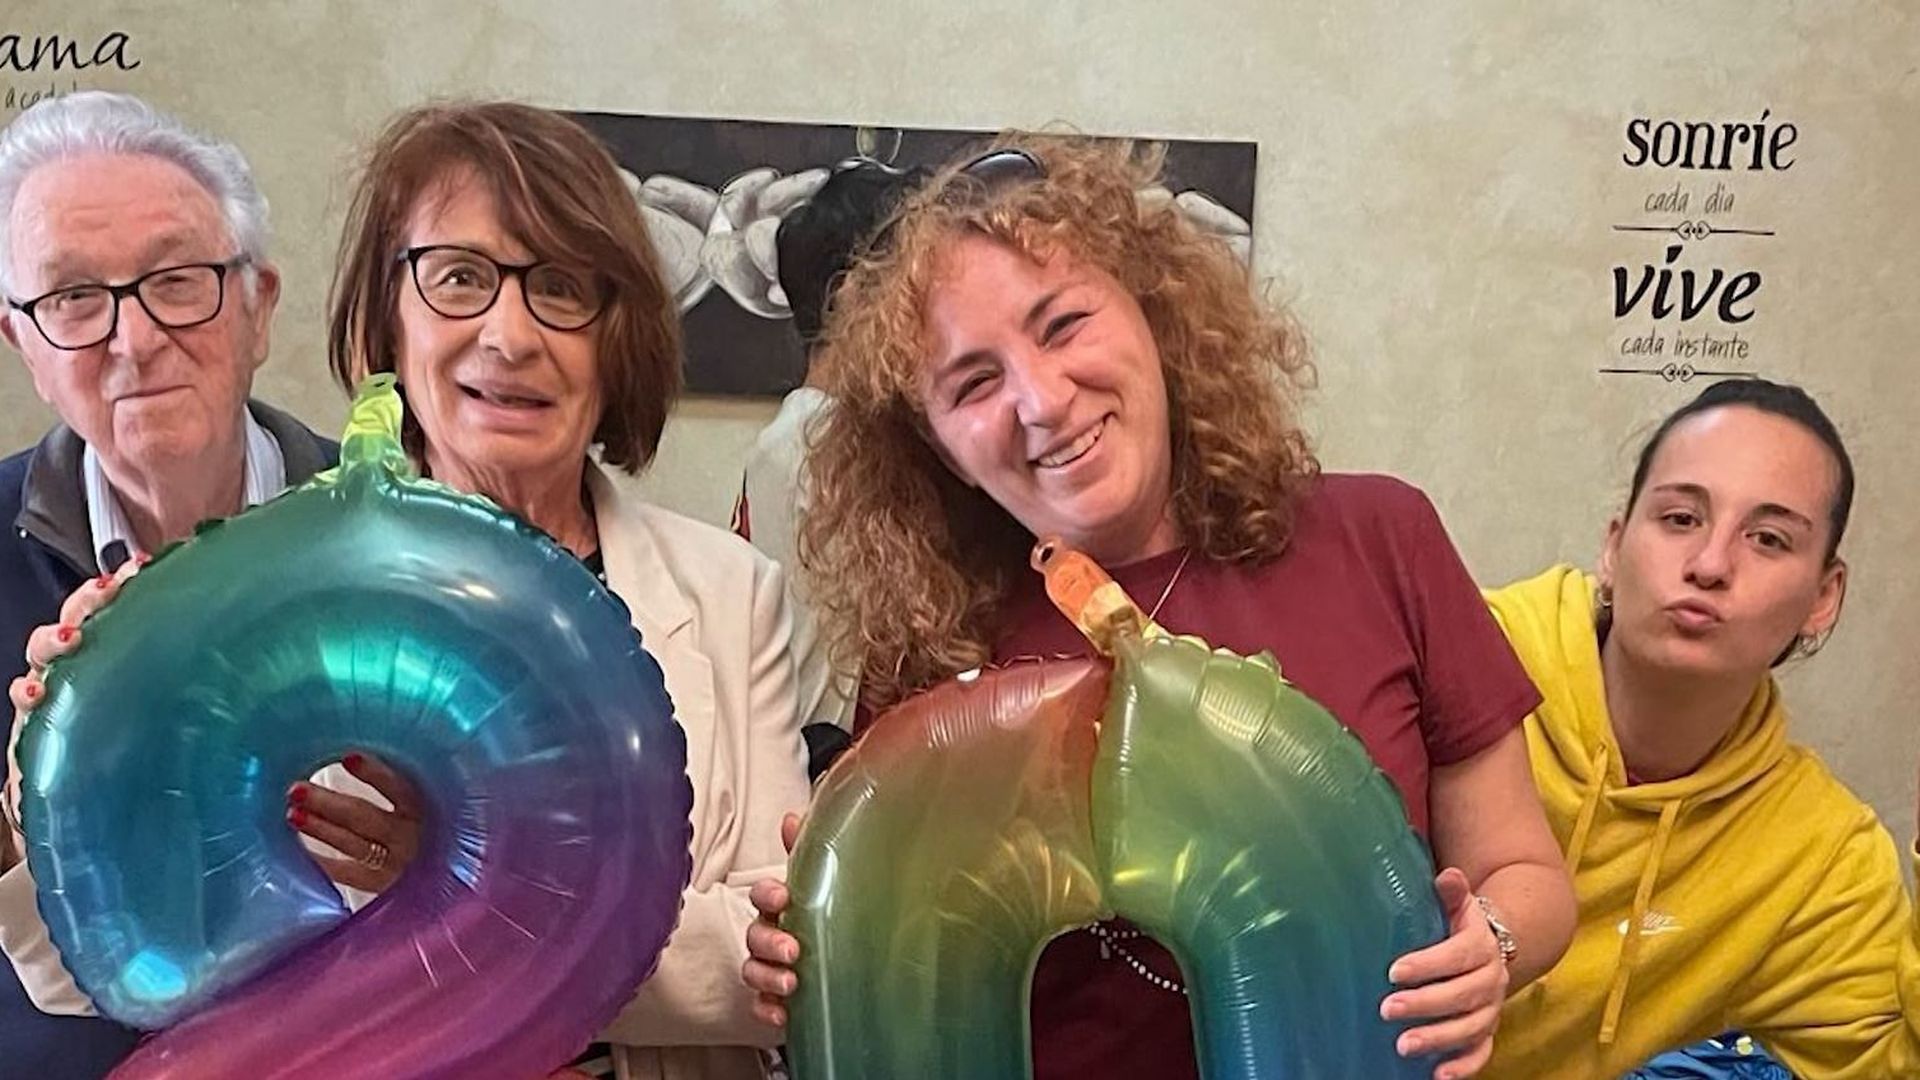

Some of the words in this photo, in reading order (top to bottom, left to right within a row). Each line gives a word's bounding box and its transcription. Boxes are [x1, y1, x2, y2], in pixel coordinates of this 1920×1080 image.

[1623, 108, 1798, 171] sonríe
[1644, 181, 1690, 213] cada
[1620, 326, 1665, 356] cada
[1673, 329, 1750, 360] instante
